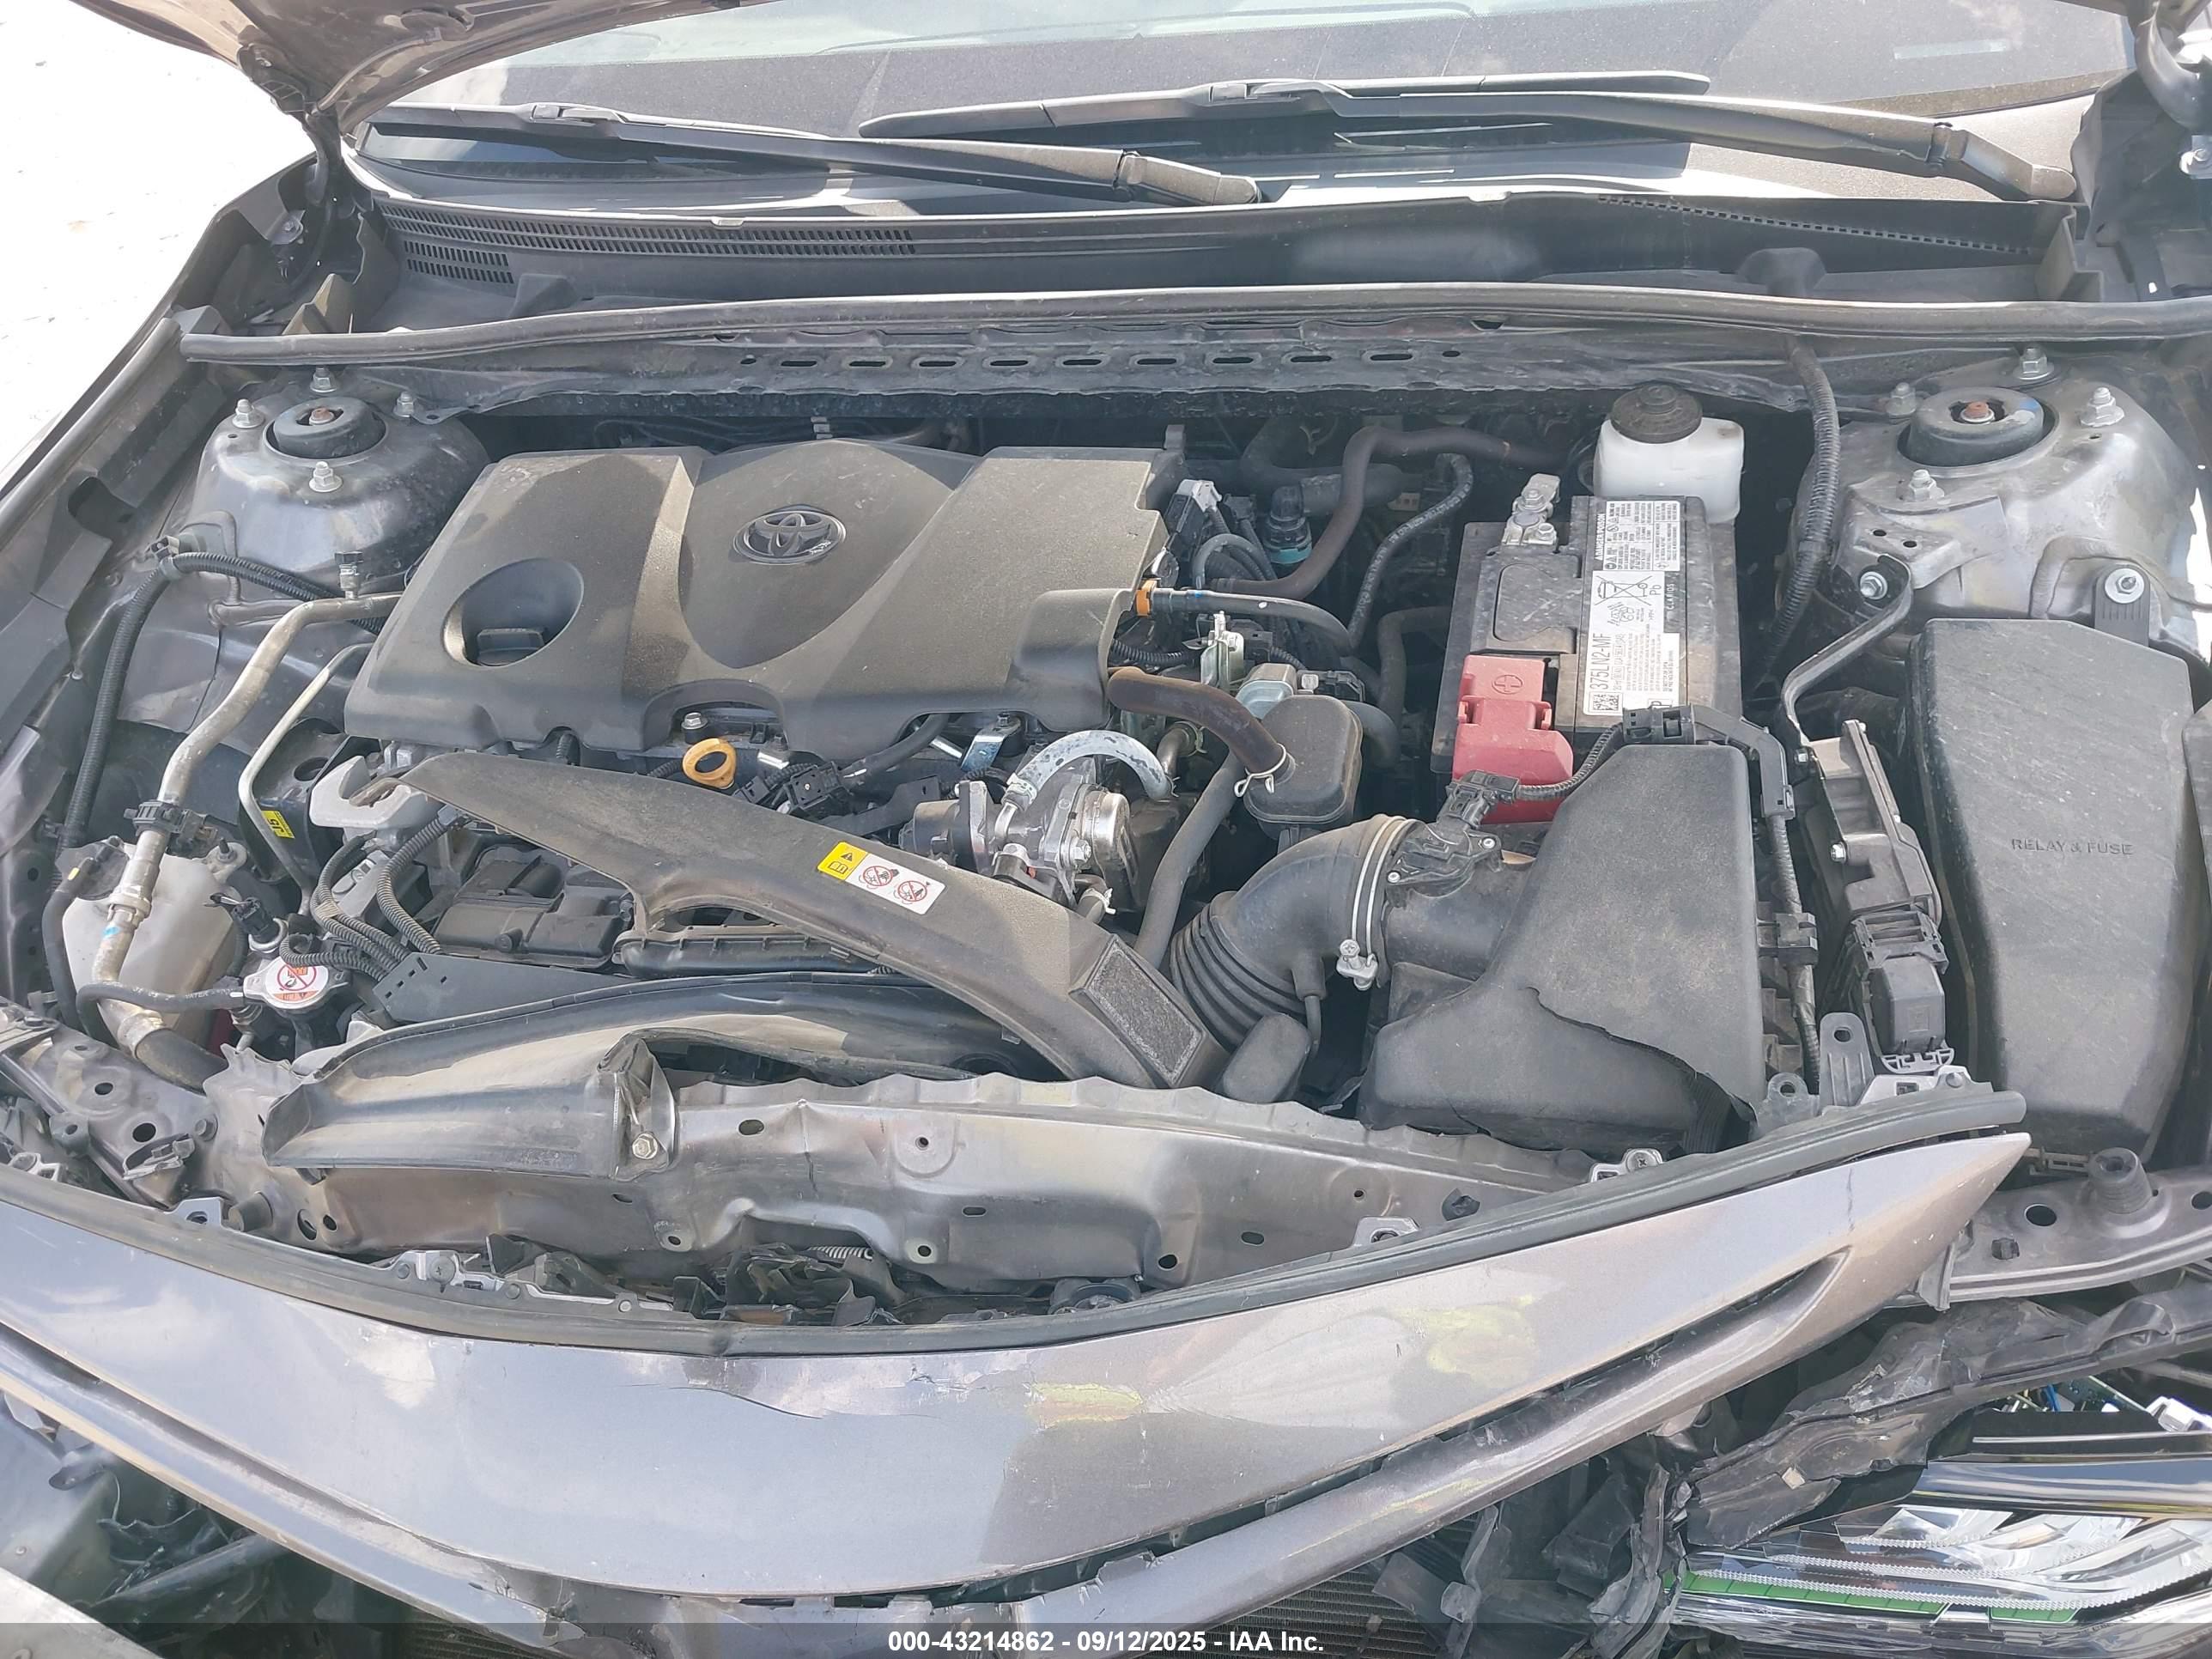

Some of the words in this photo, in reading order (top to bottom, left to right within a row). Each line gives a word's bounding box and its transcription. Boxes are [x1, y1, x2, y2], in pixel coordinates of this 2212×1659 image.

[1649, 584, 1662, 596] Pb
[1666, 583, 1675, 610] CLARIOS
[1589, 633, 1611, 690] 375LN2-MF
[267, 818, 283, 833] J5
[2012, 838, 2065, 852] RELAY
[2069, 843, 2082, 853] &
[2087, 842, 2134, 855] FUSE
